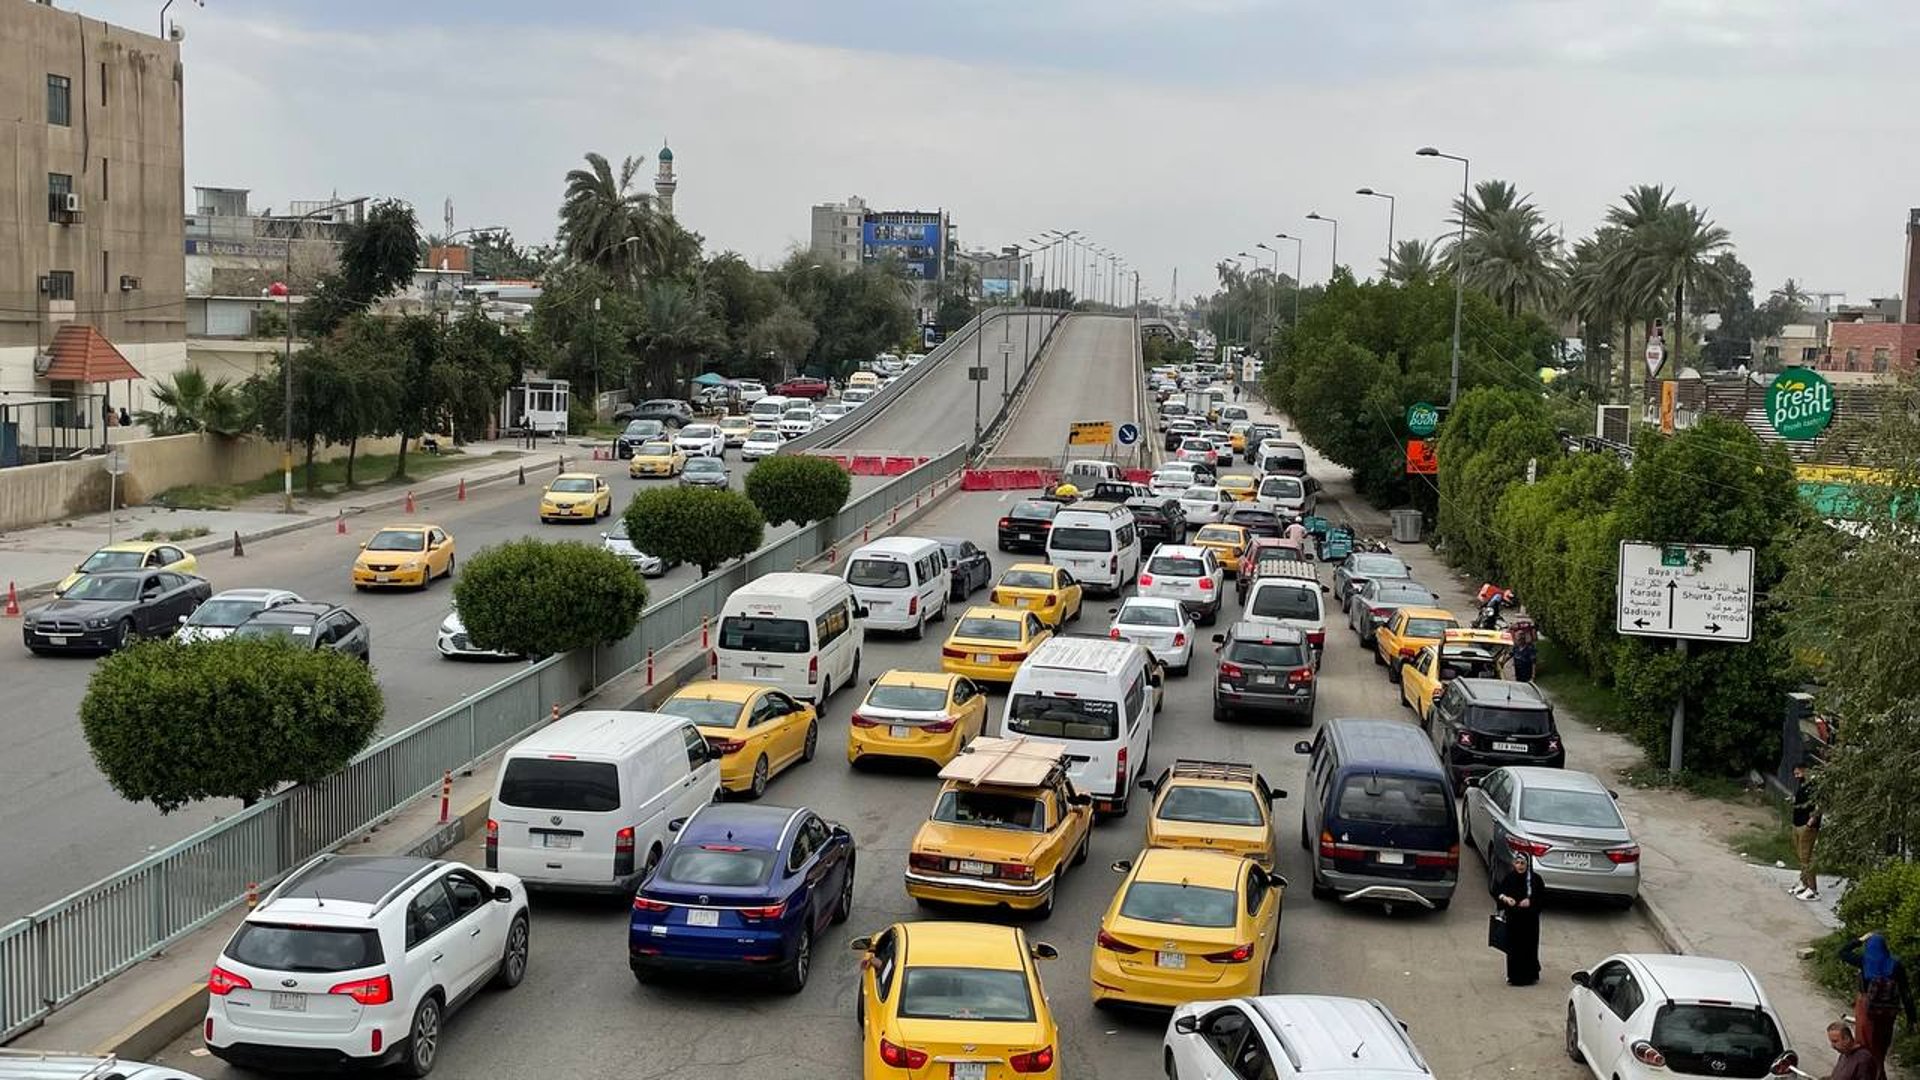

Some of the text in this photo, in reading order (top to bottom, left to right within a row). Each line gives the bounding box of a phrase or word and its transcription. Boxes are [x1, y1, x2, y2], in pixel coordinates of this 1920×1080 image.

[1776, 381, 1827, 409] fresh
[1774, 399, 1831, 427] point
[1648, 566, 1670, 577] Baya
[1630, 588, 1662, 598] Karada
[1682, 590, 1747, 603] Shurta Tunnel
[1623, 607, 1661, 618] Qadisiya
[1705, 611, 1745, 622] Yarmouk
